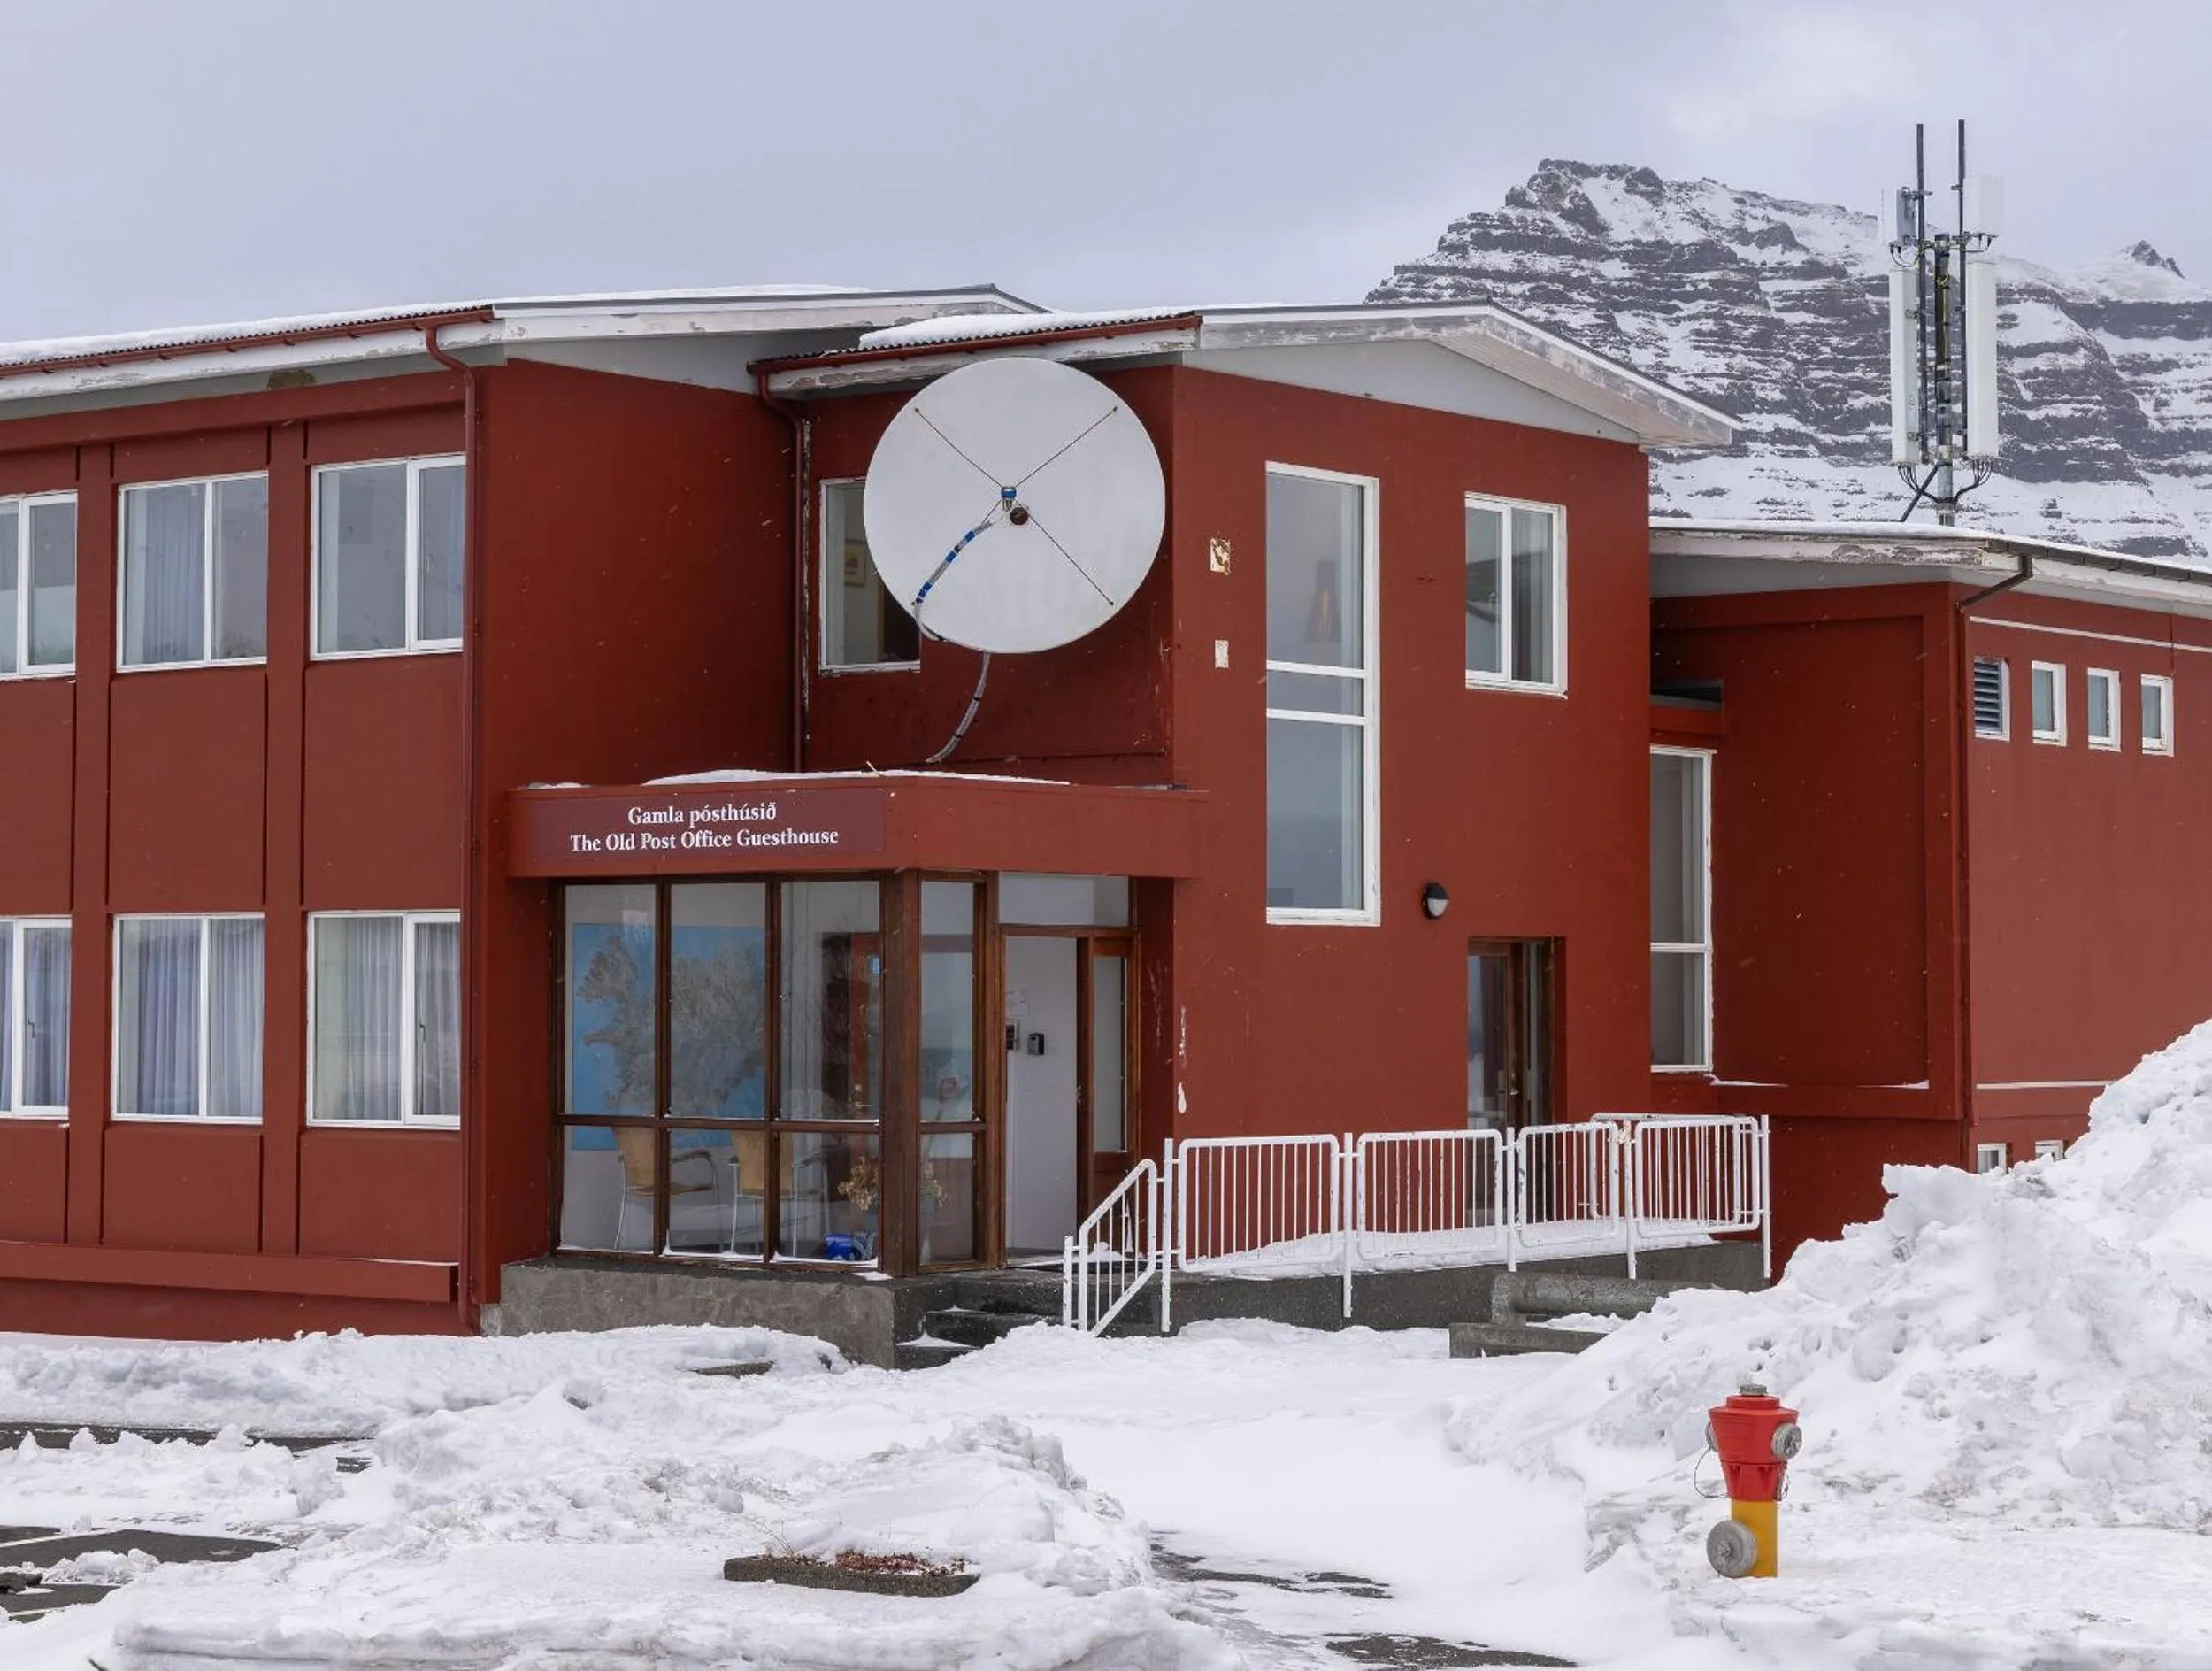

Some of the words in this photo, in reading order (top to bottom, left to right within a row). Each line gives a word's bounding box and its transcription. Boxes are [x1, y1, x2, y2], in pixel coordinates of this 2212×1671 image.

[627, 806, 684, 825] Gamla
[689, 801, 777, 828] pósthúsið
[570, 834, 601, 851] The
[605, 832, 635, 850] Old
[641, 832, 676, 850] Post
[680, 829, 732, 849] Office
[736, 827, 839, 846] Guesthouse
